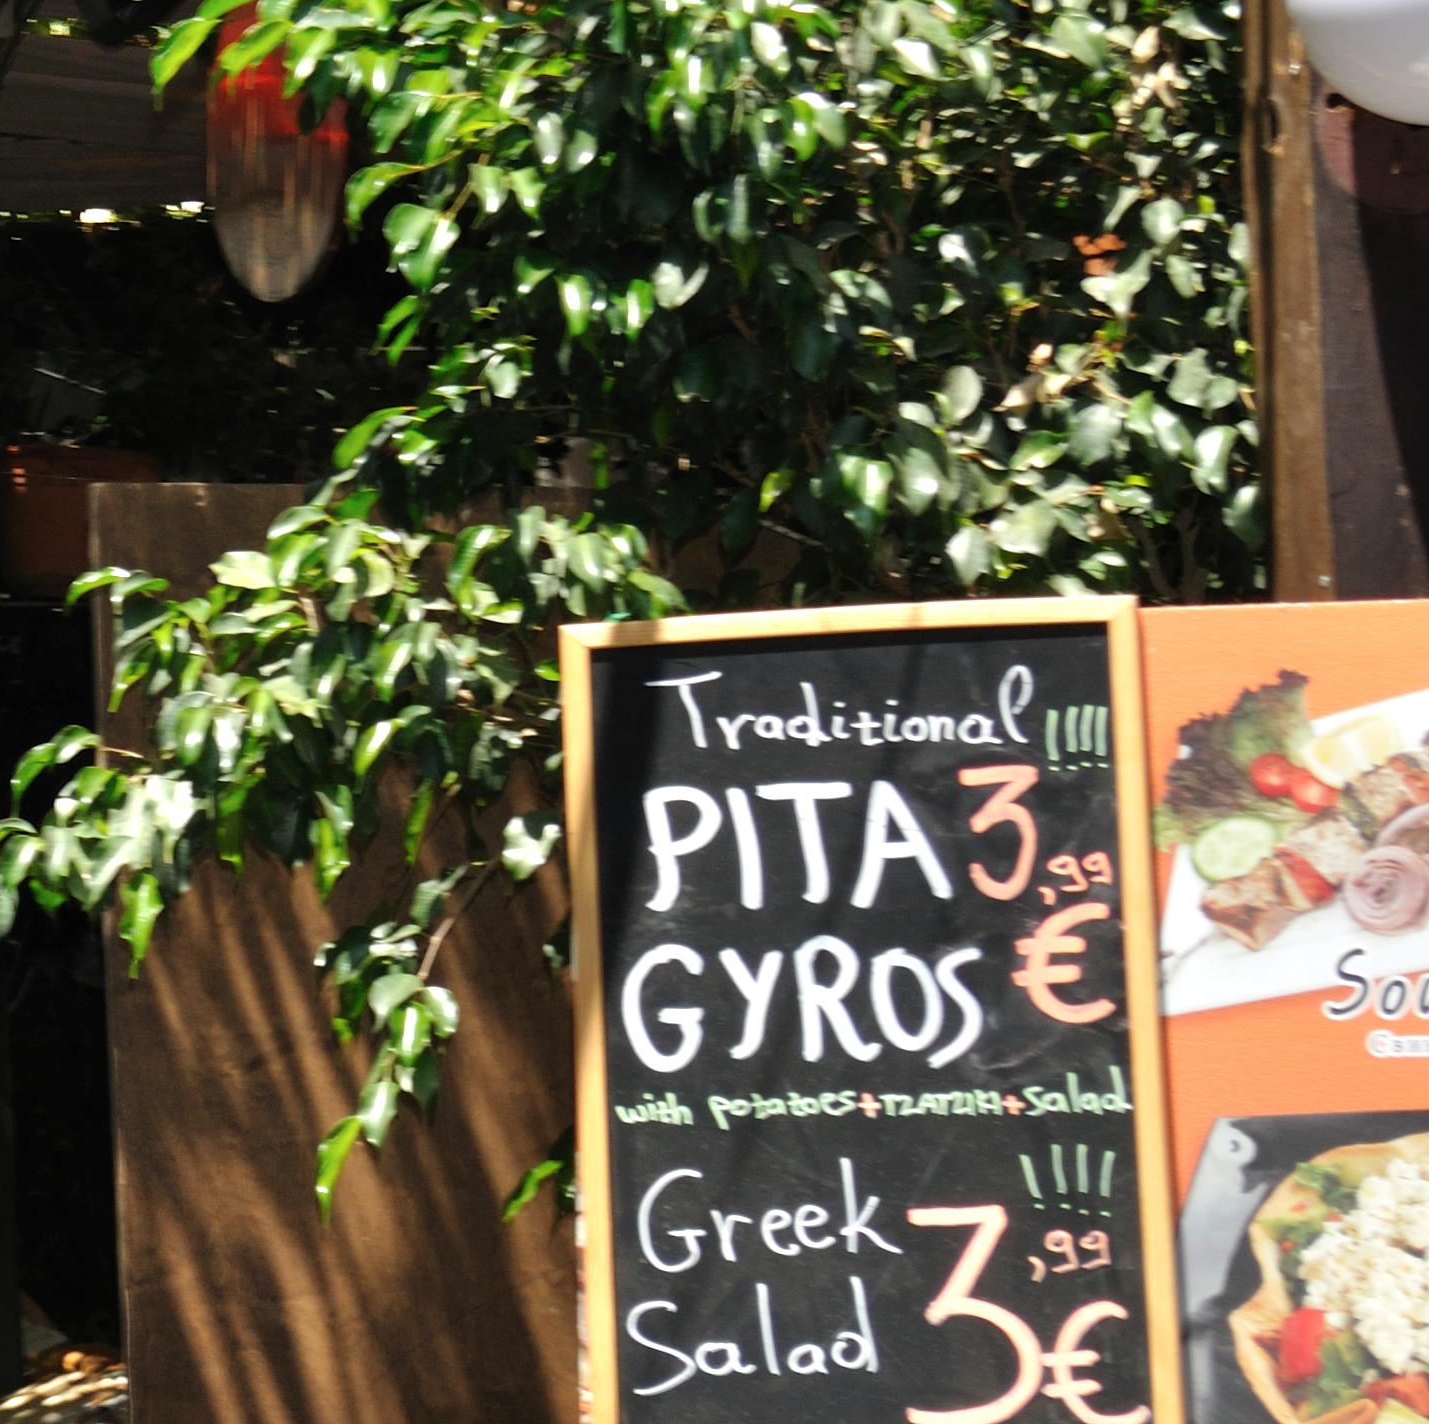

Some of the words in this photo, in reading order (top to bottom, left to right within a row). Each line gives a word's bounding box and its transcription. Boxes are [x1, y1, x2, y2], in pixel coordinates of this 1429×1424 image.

[644, 663, 1034, 752] Traditional
[642, 779, 954, 913] PITA
[620, 936, 983, 1074] GYROS
[615, 1092, 693, 1127] with
[636, 1158, 903, 1274] Greek
[625, 1276, 880, 1397] Salad
